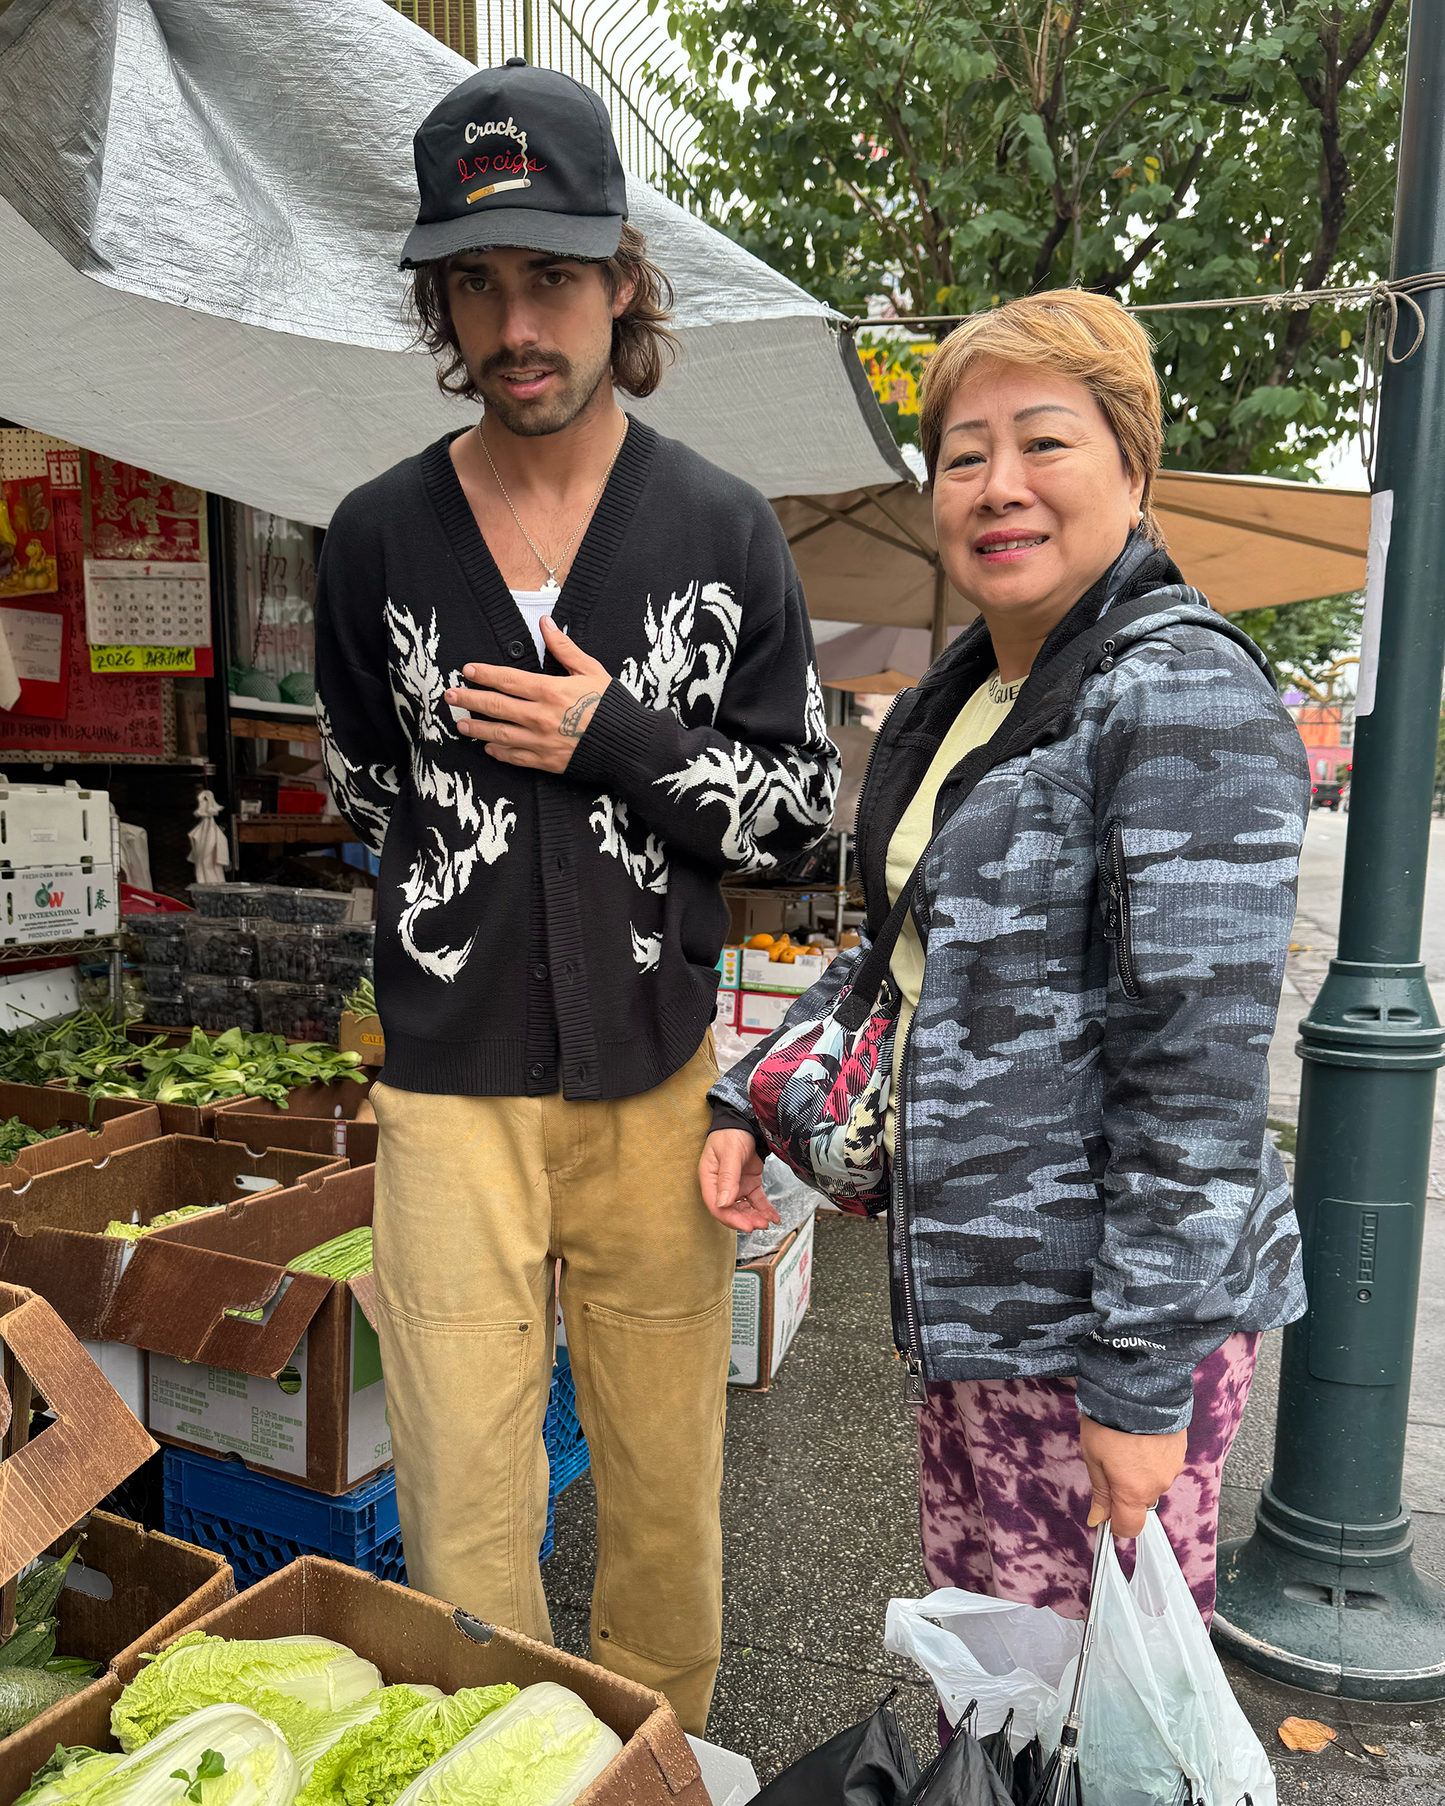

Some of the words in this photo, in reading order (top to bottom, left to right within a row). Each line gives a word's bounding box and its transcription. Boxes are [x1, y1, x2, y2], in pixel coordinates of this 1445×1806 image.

[465, 116, 527, 145] Cracks
[492, 150, 548, 175] cigs
[143, 566, 151, 576] 1
[96, 650, 135, 669] 2026
[29, 908, 81, 920] INTERNATIONAL
[28, 930, 53, 939] PRODUCT
[62, 928, 73, 936] USA
[1358, 1214, 1377, 1282] LUMEC
[1112, 1336, 1167, 1351] COUNTRY
